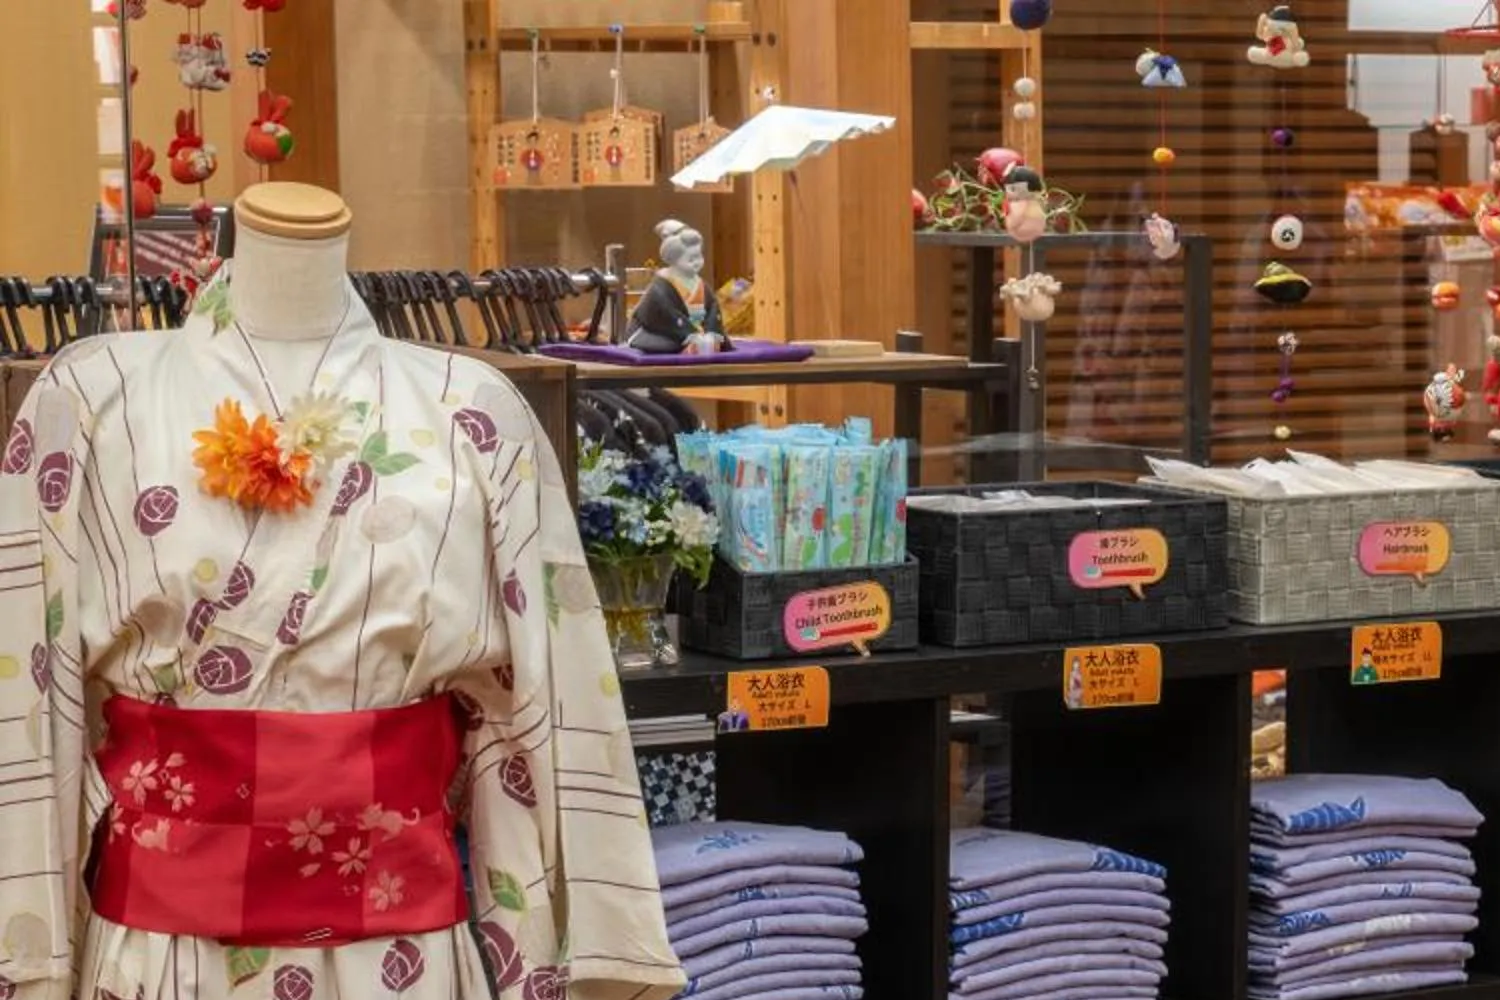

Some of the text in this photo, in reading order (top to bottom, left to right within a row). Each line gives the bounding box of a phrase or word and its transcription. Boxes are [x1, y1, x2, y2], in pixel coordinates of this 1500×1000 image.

[1091, 552, 1149, 565] Toothbrush
[795, 603, 883, 630] Child Toothbrush
[1372, 626, 1422, 644] 大人浴衣
[1084, 647, 1140, 668] 大人浴衣
[746, 672, 805, 692] 大人浴衣
